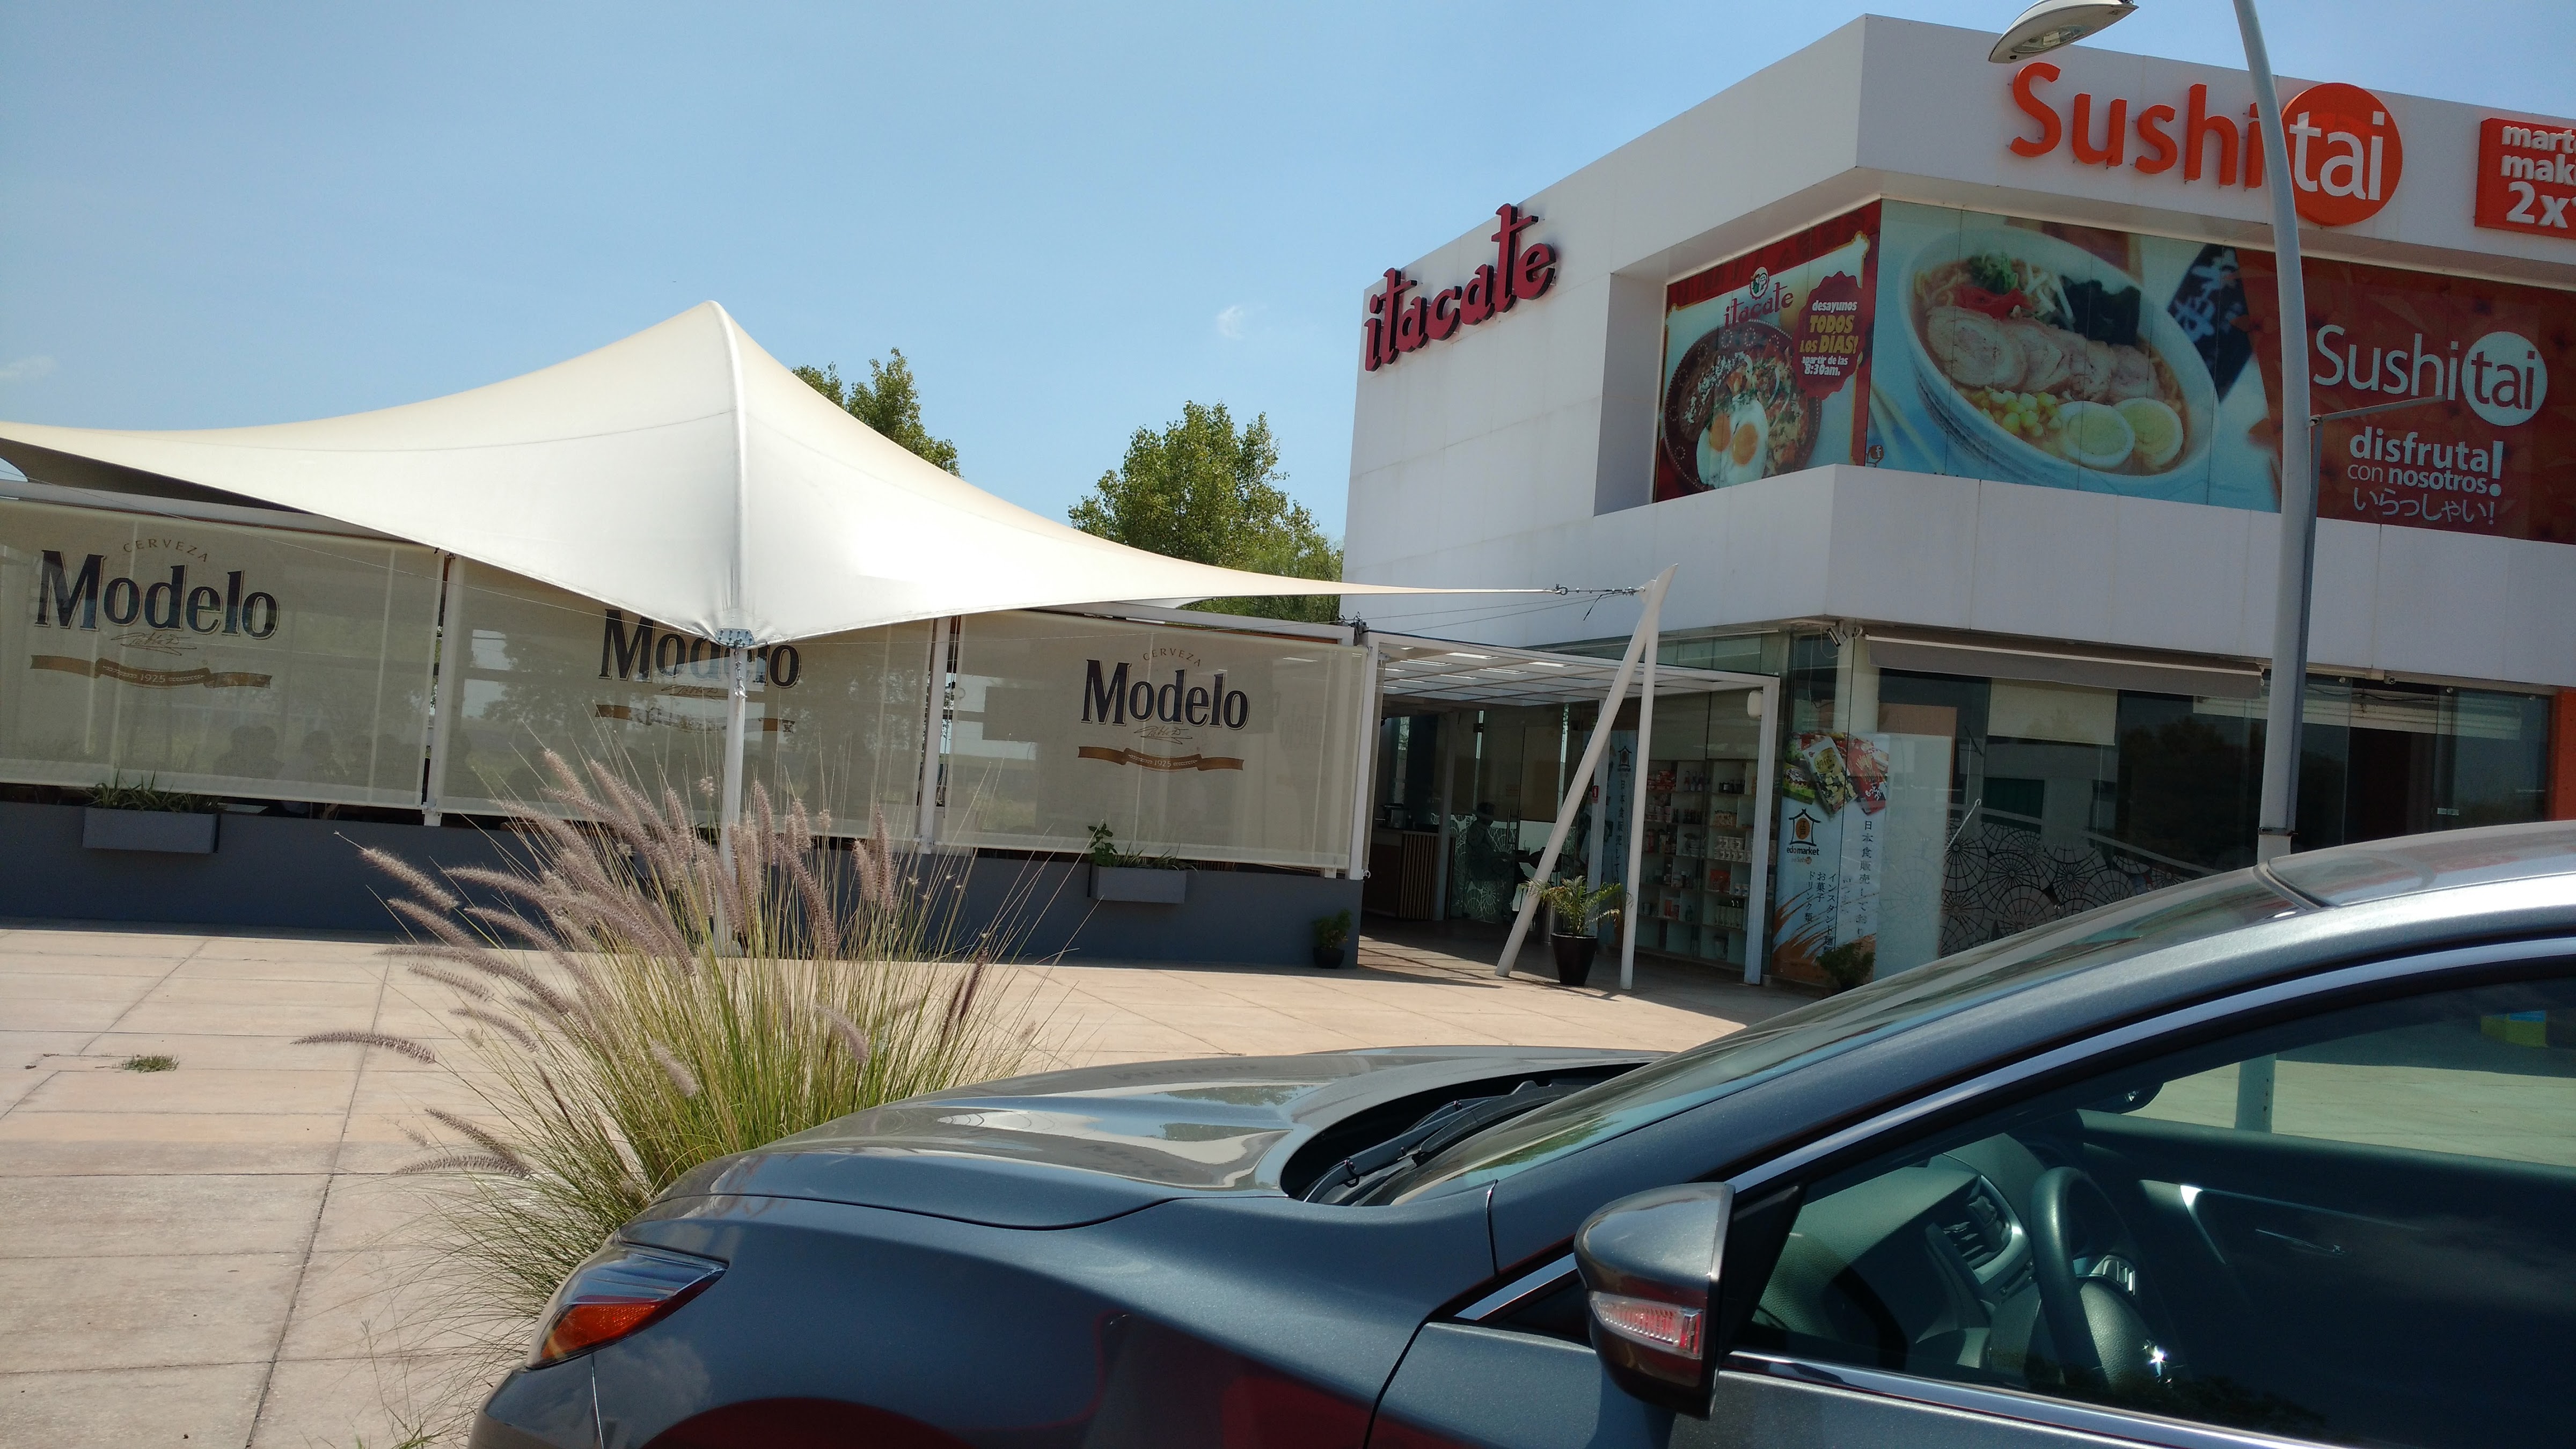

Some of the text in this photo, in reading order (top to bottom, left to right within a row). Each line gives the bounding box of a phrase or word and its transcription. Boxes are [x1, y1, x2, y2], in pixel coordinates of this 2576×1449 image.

[2009, 62, 2385, 202] Sushi tai
[2501, 125, 2576, 154] mart
[2500, 153, 2576, 187] mak
[2506, 181, 2576, 229] 2x
[1364, 203, 1556, 372] itacate
[1723, 282, 1794, 329] itacate
[1812, 300, 1858, 313] desayunos
[1810, 315, 1855, 334] TODOS
[1799, 331, 1859, 354] LOS DÍAS!
[1827, 355, 1836, 364] de
[1837, 356, 1849, 365] las
[2313, 324, 2536, 410] Sushi tai
[2347, 464, 2487, 495] con nosotros
[123, 538, 209, 562] CERVEZA
[34, 549, 281, 641] Modelo
[1143, 647, 1202, 667] CERVEZA
[140, 674, 166, 683] 1925
[1080, 659, 1250, 730] Modelo
[1154, 759, 1172, 767] 1925
[1816, 872, 1826, 903] お菓子
